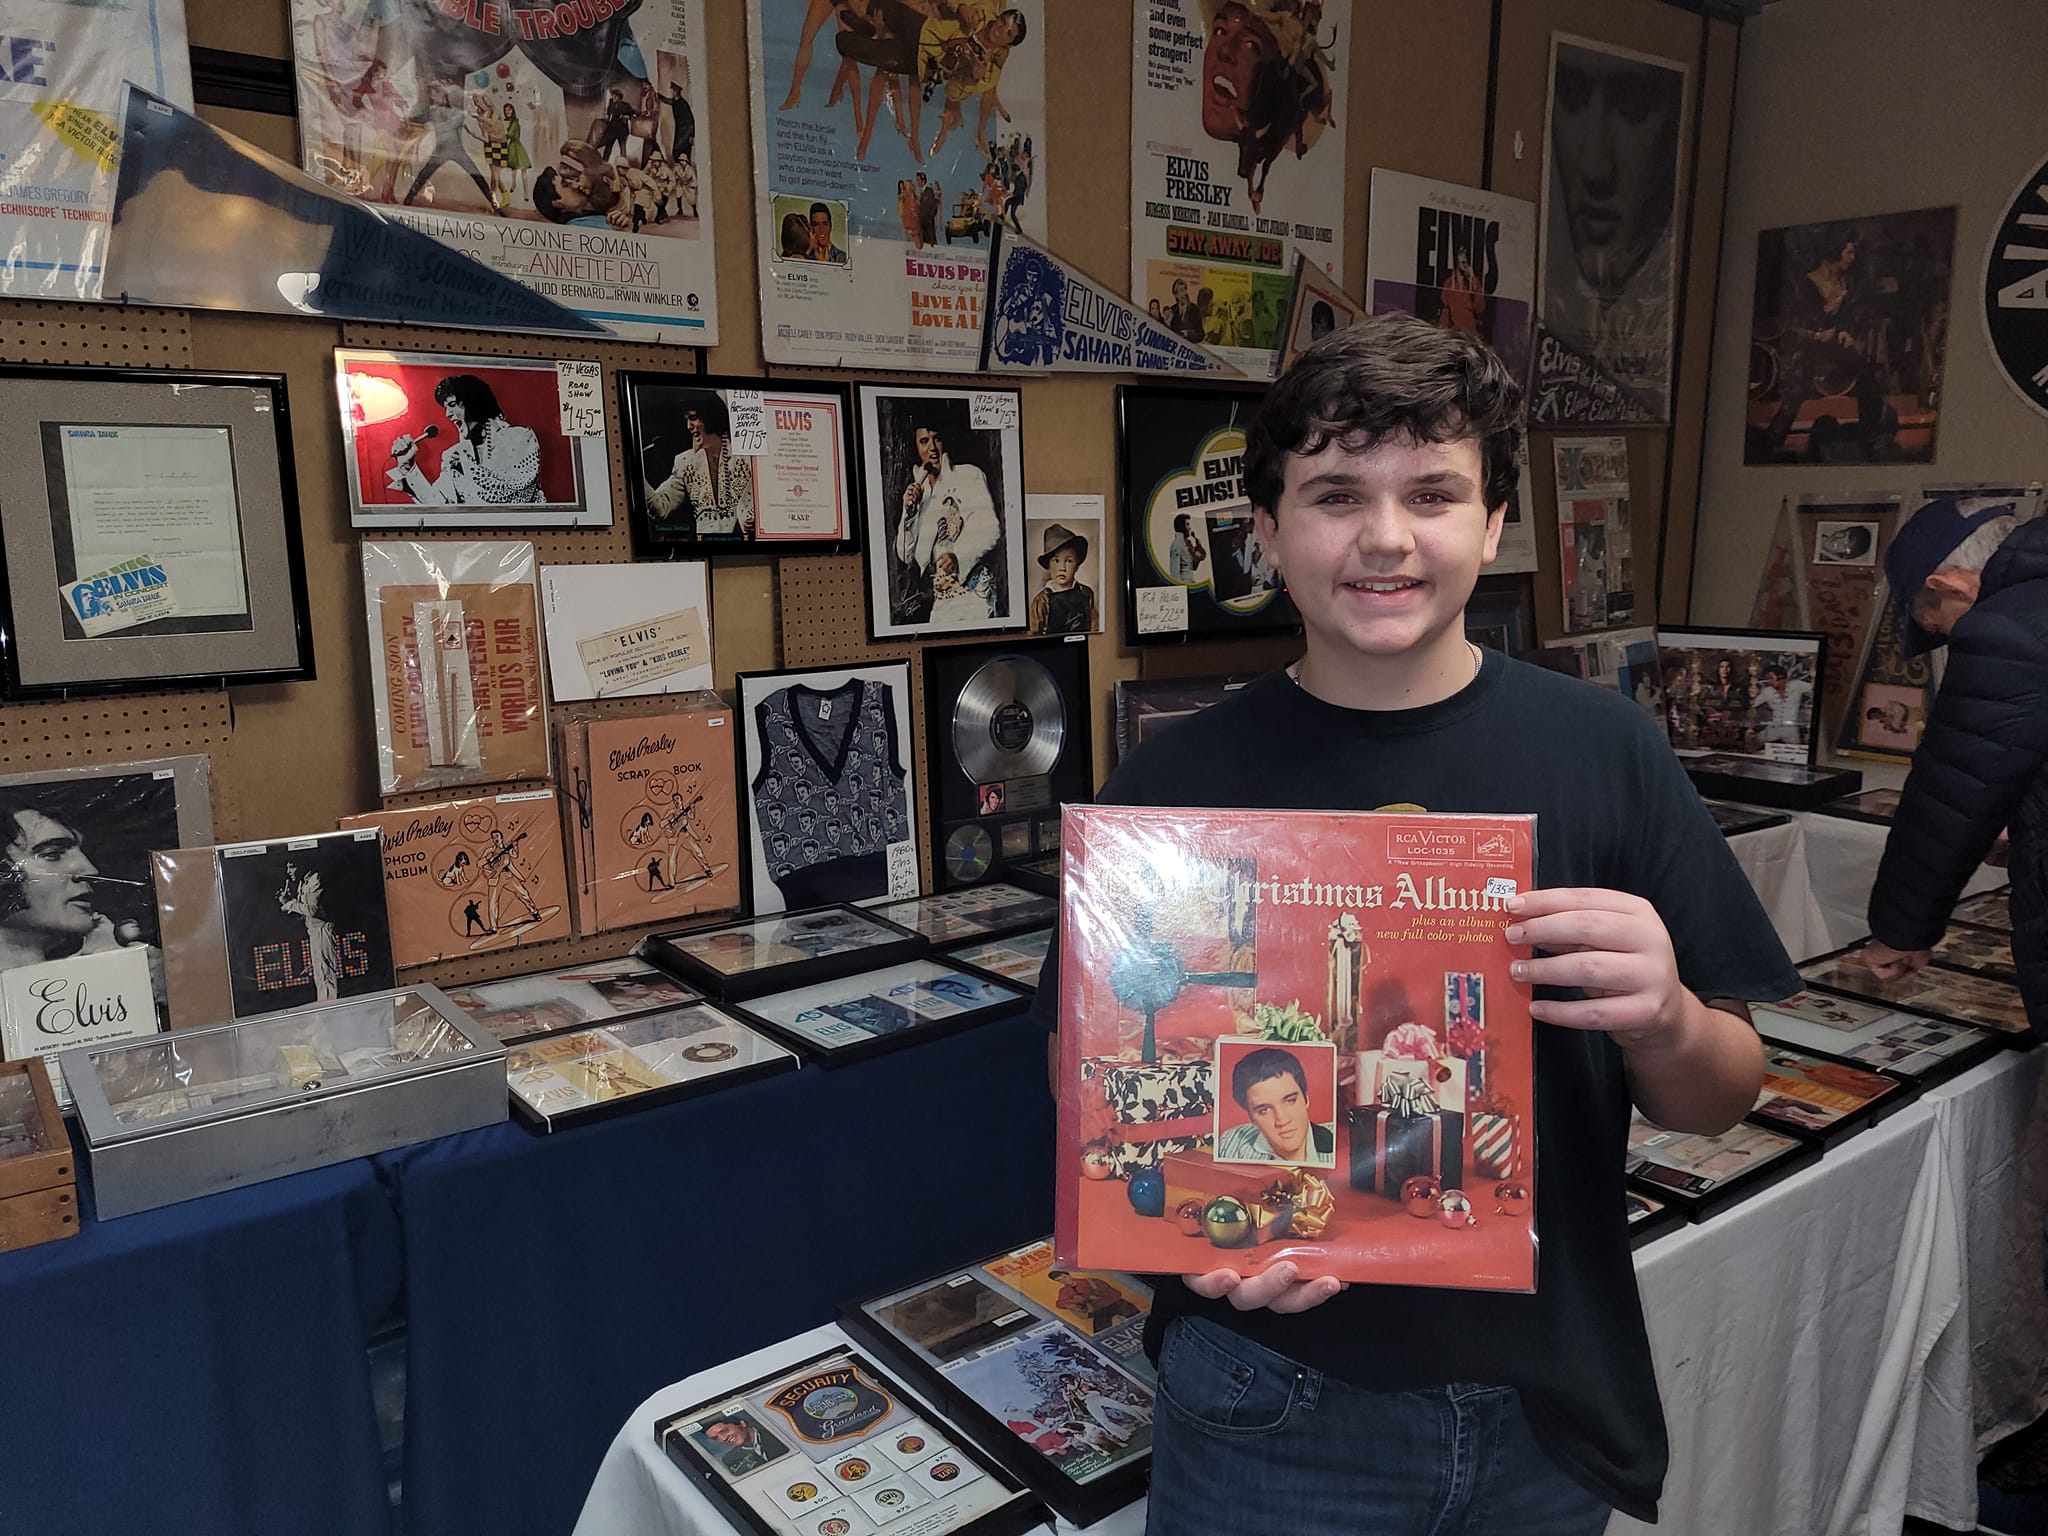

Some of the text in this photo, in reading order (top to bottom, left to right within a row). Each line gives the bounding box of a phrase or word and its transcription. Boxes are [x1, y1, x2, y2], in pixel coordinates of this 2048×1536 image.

[1149, 8, 1186, 28] and even
[1148, 26, 1203, 50] some perfect
[1148, 42, 1192, 64] strangers!
[67, 114, 84, 129] SING
[72, 108, 92, 122] HEAR
[776, 117, 836, 135] Watch the birdie
[67, 125, 97, 150] VICTOR
[776, 129, 818, 143] and the fun
[777, 140, 793, 150] with
[794, 142, 816, 153] ELVIS
[777, 151, 806, 165] playboy
[808, 156, 831, 168] pin-up
[1166, 155, 1209, 181] ELVIS
[778, 163, 795, 172] who
[825, 170, 842, 179] want
[778, 173, 800, 185] to get
[7, 185, 90, 204] JAMES GREGORY
[1165, 177, 1232, 207] PRESLEY
[494, 224, 573, 251] YVONNE
[579, 234, 647, 259] ROMAIN
[1168, 229, 1282, 265] STAY JOE
[1416, 206, 1500, 295] ELVIS
[529, 252, 615, 283] ANNETTE
[620, 260, 655, 286] DAY
[787, 273, 808, 282] ELVIS
[905, 258, 955, 280] ELVIS
[534, 281, 558, 295] JUDD
[561, 283, 605, 300] BERNARD
[614, 288, 641, 304] IRWIN
[643, 291, 683, 307] WINKLER
[958, 286, 973, 295] you
[912, 291, 968, 311] LIVE A
[912, 310, 968, 329] LOVE A
[1135, 321, 1178, 355] SUMMER
[1063, 329, 1132, 367] SAHARA
[1539, 336, 1581, 374] Elvis
[576, 363, 600, 377] VEGAS
[568, 381, 589, 390] ROAD
[568, 390, 593, 398] SHOW
[733, 390, 759, 399] ELVIS
[737, 413, 759, 421] VEGAS
[775, 409, 812, 431] ELVIS
[1175, 480, 1234, 509] ELVIS!
[92, 564, 168, 599] ELVIS
[124, 581, 169, 598] CONCERT
[587, 658, 601, 667] BACK
[600, 664, 625, 678] "LOVING
[625, 661, 640, 672] YOU"
[386, 632, 407, 734] COMING SOON
[491, 679, 498, 689] AT
[494, 618, 529, 736] WORLD'S FAIR
[608, 733, 677, 772] Elvis Presley
[617, 762, 702, 782] SCRAP BOOK
[383, 815, 454, 853] lvis Presley
[1396, 830, 1468, 846] RCA VICTOR
[384, 851, 426, 866] PHOTO
[1407, 847, 1456, 855] LOC-1035
[386, 864, 428, 880] ALBUM
[891, 866, 914, 882] Youth
[1449, 861, 1463, 869] High
[1463, 861, 1485, 869] Fidelity
[1485, 862, 1515, 870] Recording
[1411, 914, 1513, 931] plus an album of
[1374, 929, 1495, 944] new full color photos
[887, 983, 915, 997] 45
[28, 978, 128, 1035] Elvis
[910, 995, 945, 1009] ELVIS
[794, 1009, 825, 1024] 45
[814, 1022, 853, 1037] ELVIS
[40, 1043, 60, 1051] MEMORY
[779, 1372, 850, 1408] SECURITY
[818, 1405, 882, 1440] Graceland
